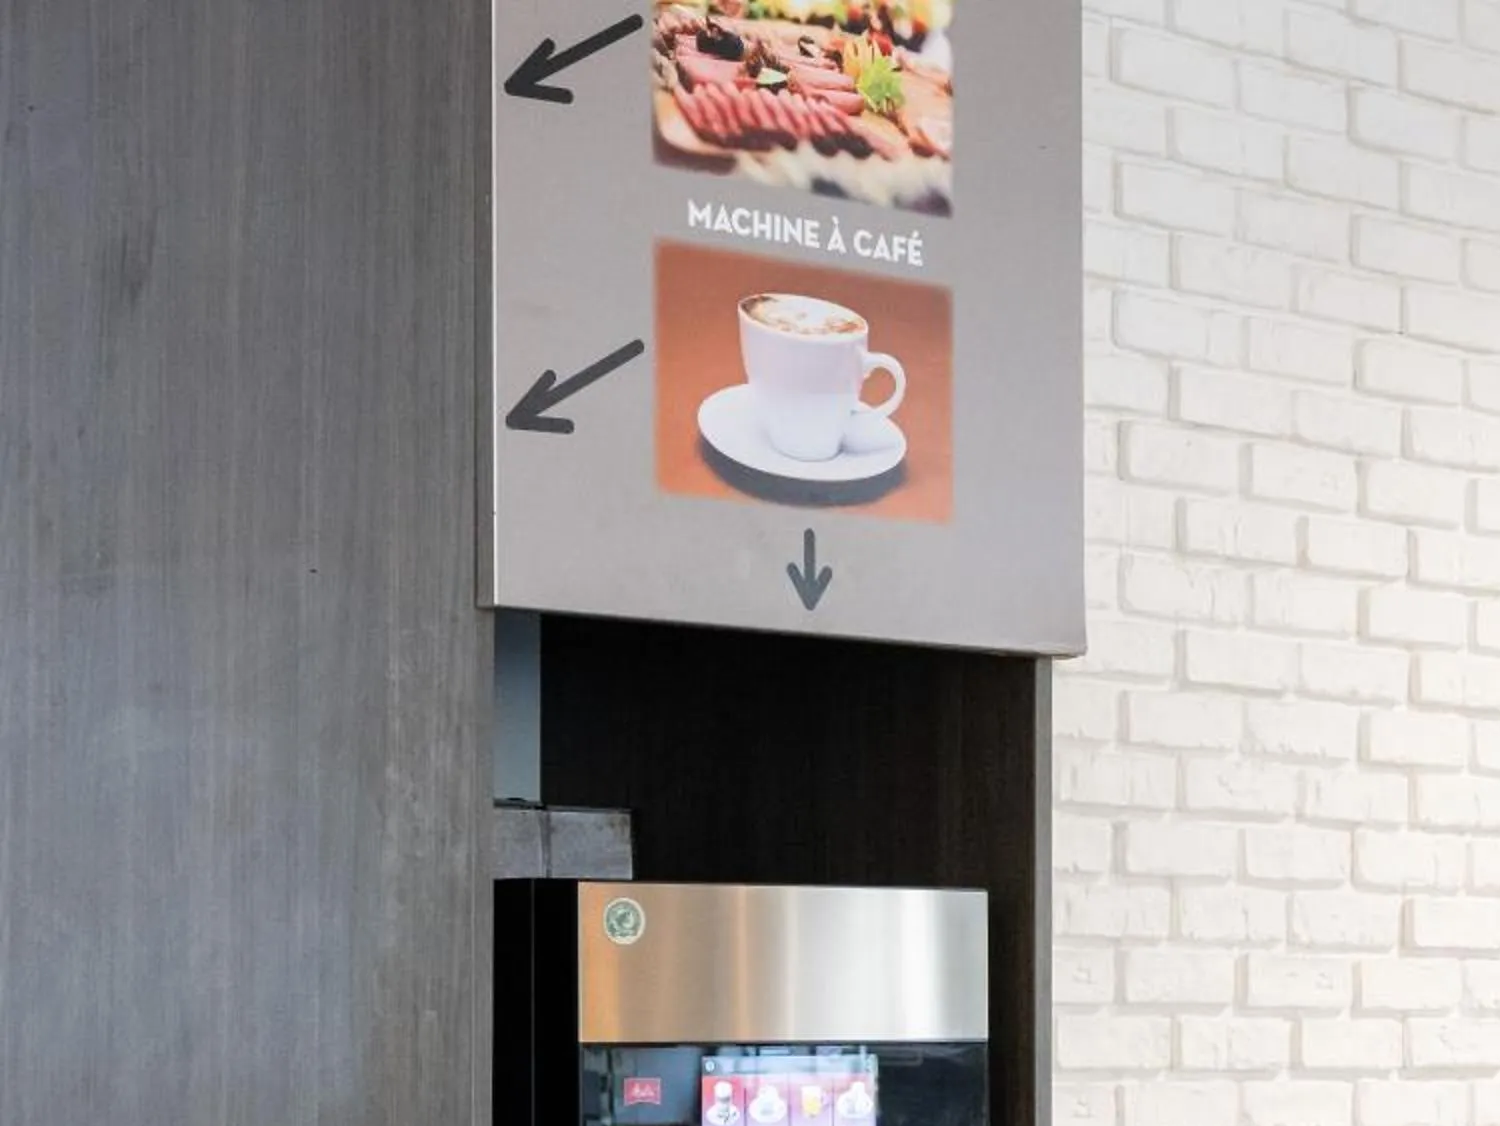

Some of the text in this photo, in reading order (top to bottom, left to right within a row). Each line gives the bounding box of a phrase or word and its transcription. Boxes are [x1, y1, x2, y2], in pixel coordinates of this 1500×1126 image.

[687, 199, 924, 267] MACHINE À CAFÉ
